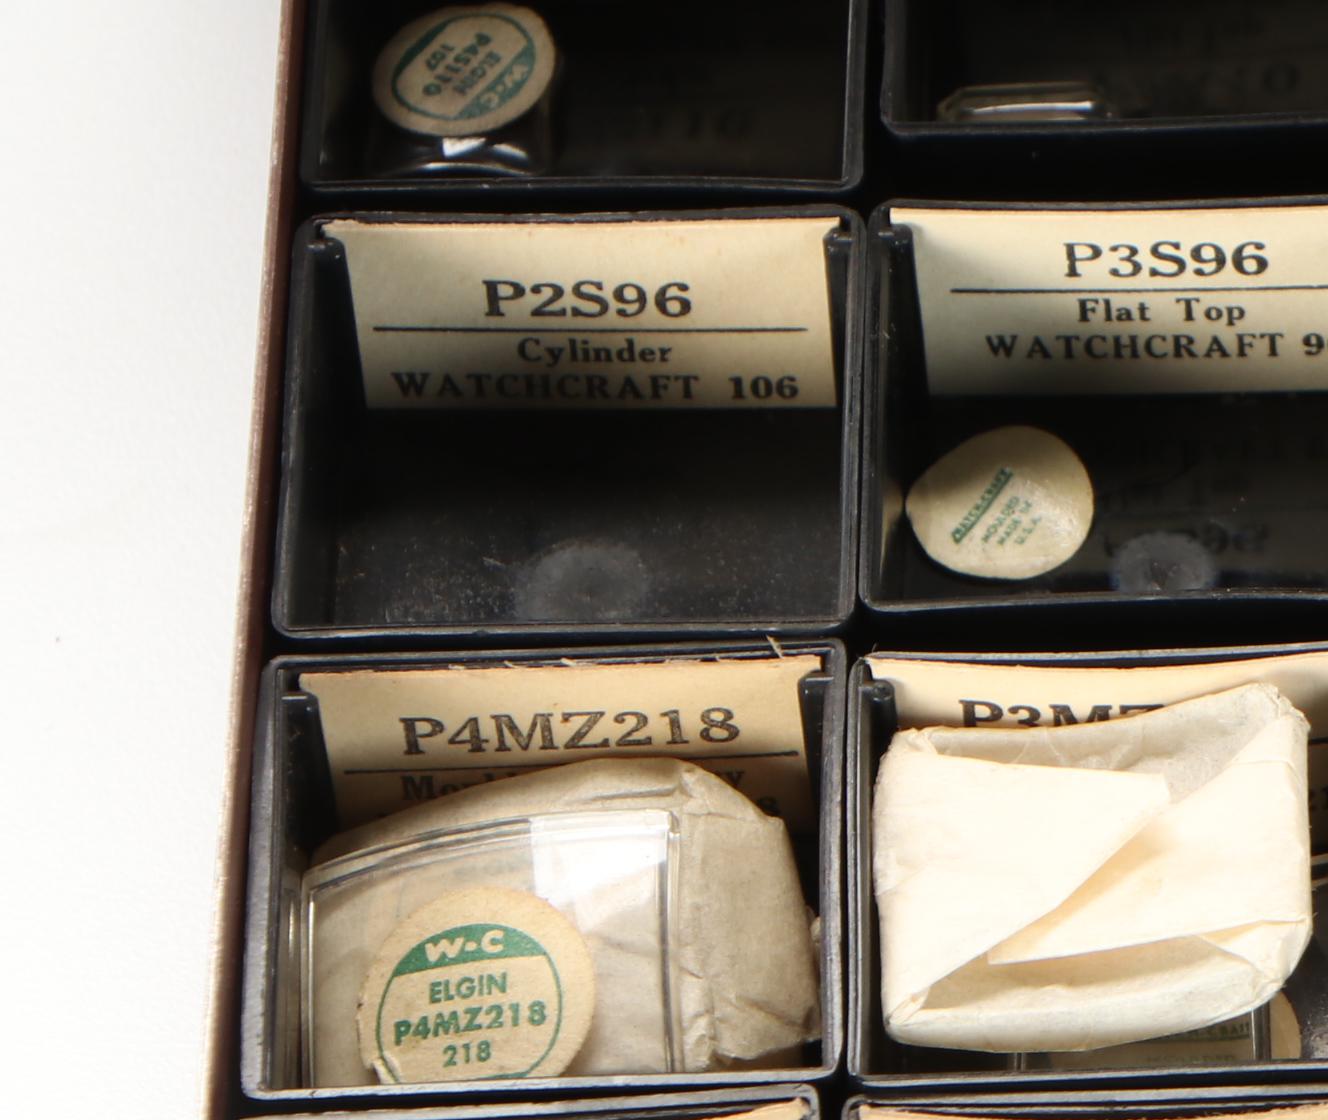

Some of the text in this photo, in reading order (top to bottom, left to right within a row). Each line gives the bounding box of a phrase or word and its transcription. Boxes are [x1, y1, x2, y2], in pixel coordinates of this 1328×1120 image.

[1063, 241, 1269, 279] P3S96
[482, 279, 692, 320] P2S96
[1077, 297, 1246, 326] Flat Top
[516, 337, 673, 366] Cylinder
[985, 332, 1284, 360] WATCHCRAFT
[391, 371, 799, 401] WATCHCRAFT 106
[399, 707, 740, 756] P4MZ218
[424, 929, 504, 962] W-C
[429, 971, 507, 1004] ELGIN
[394, 999, 547, 1046] P4MZ218
[442, 1039, 491, 1068] 218
